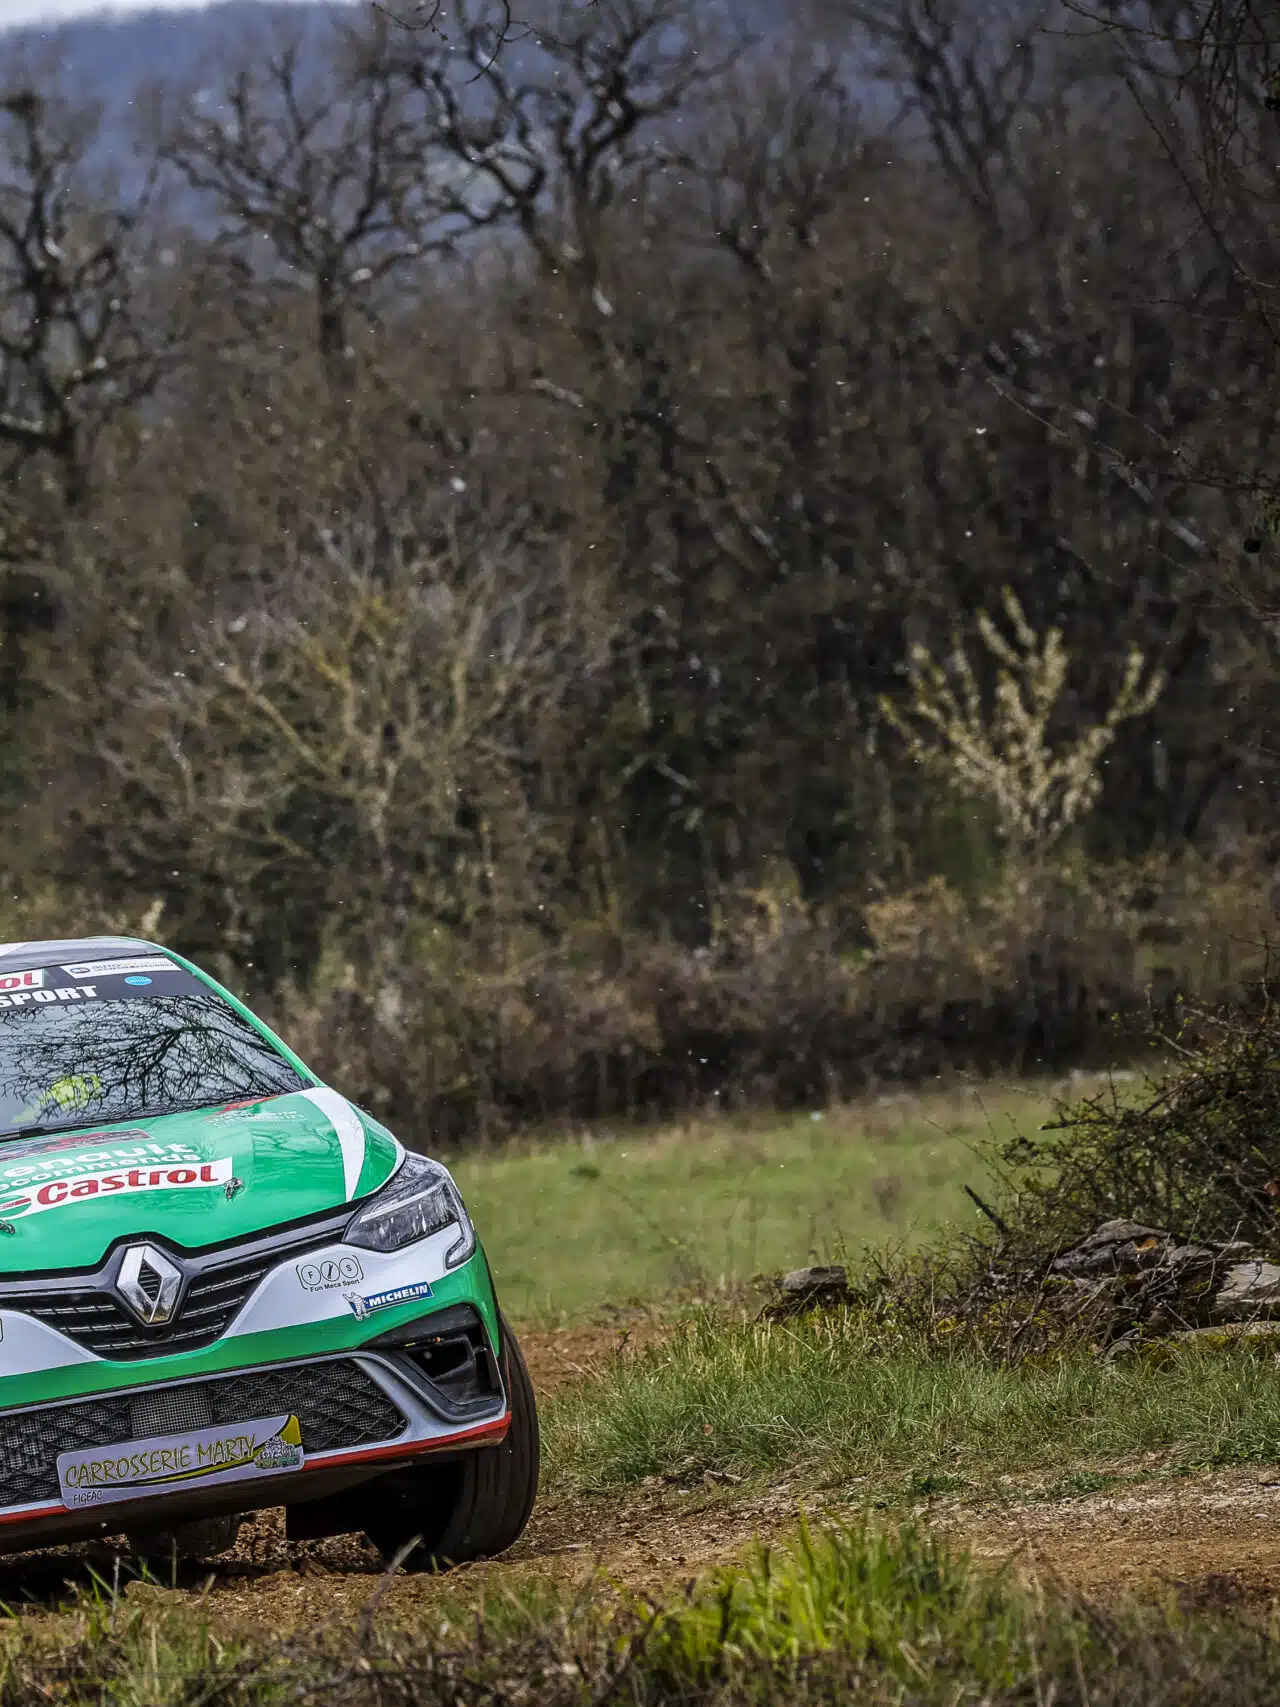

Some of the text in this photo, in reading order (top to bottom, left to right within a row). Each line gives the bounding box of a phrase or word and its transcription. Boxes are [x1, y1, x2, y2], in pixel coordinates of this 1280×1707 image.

[36, 1164, 219, 1206] Castrol
[310, 1278, 361, 1293] Fun Meca Sport
[368, 1284, 429, 1307] MICHELIN
[64, 1433, 257, 1489] CARROSSERIE MARTY
[72, 1489, 103, 1504] FIGEAC
